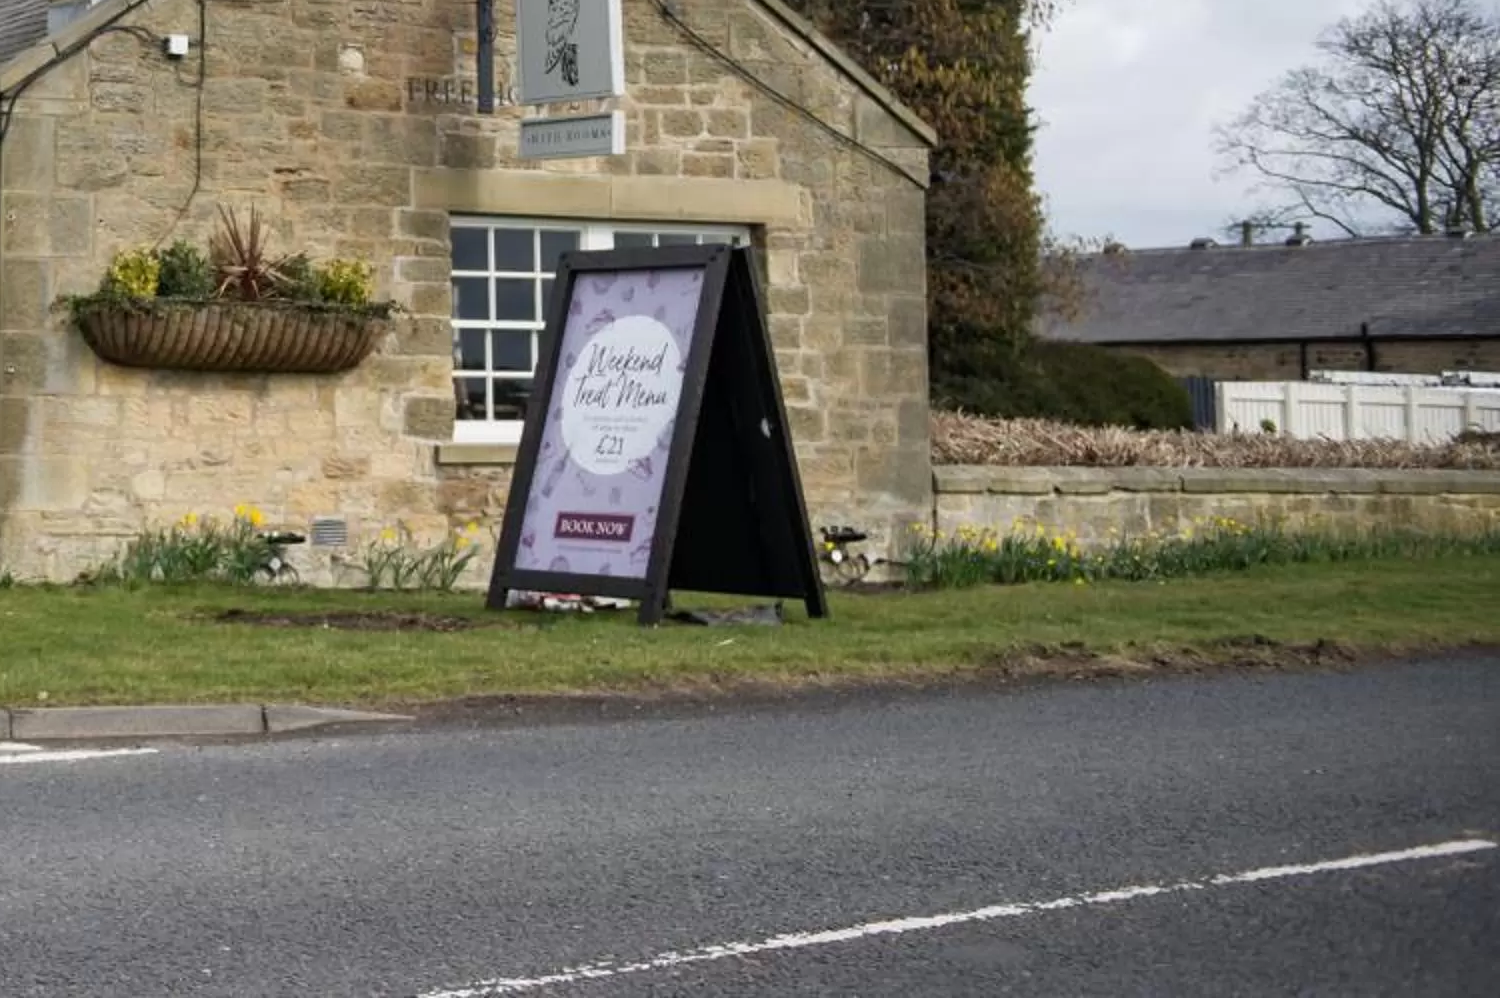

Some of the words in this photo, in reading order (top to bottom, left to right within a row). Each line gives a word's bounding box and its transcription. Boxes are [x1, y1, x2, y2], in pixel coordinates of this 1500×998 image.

[587, 341, 669, 376] Weekend
[572, 374, 612, 409] Treat
[614, 370, 668, 409] Menu
[560, 518, 595, 533] BOOK
[595, 521, 629, 536] NOW
